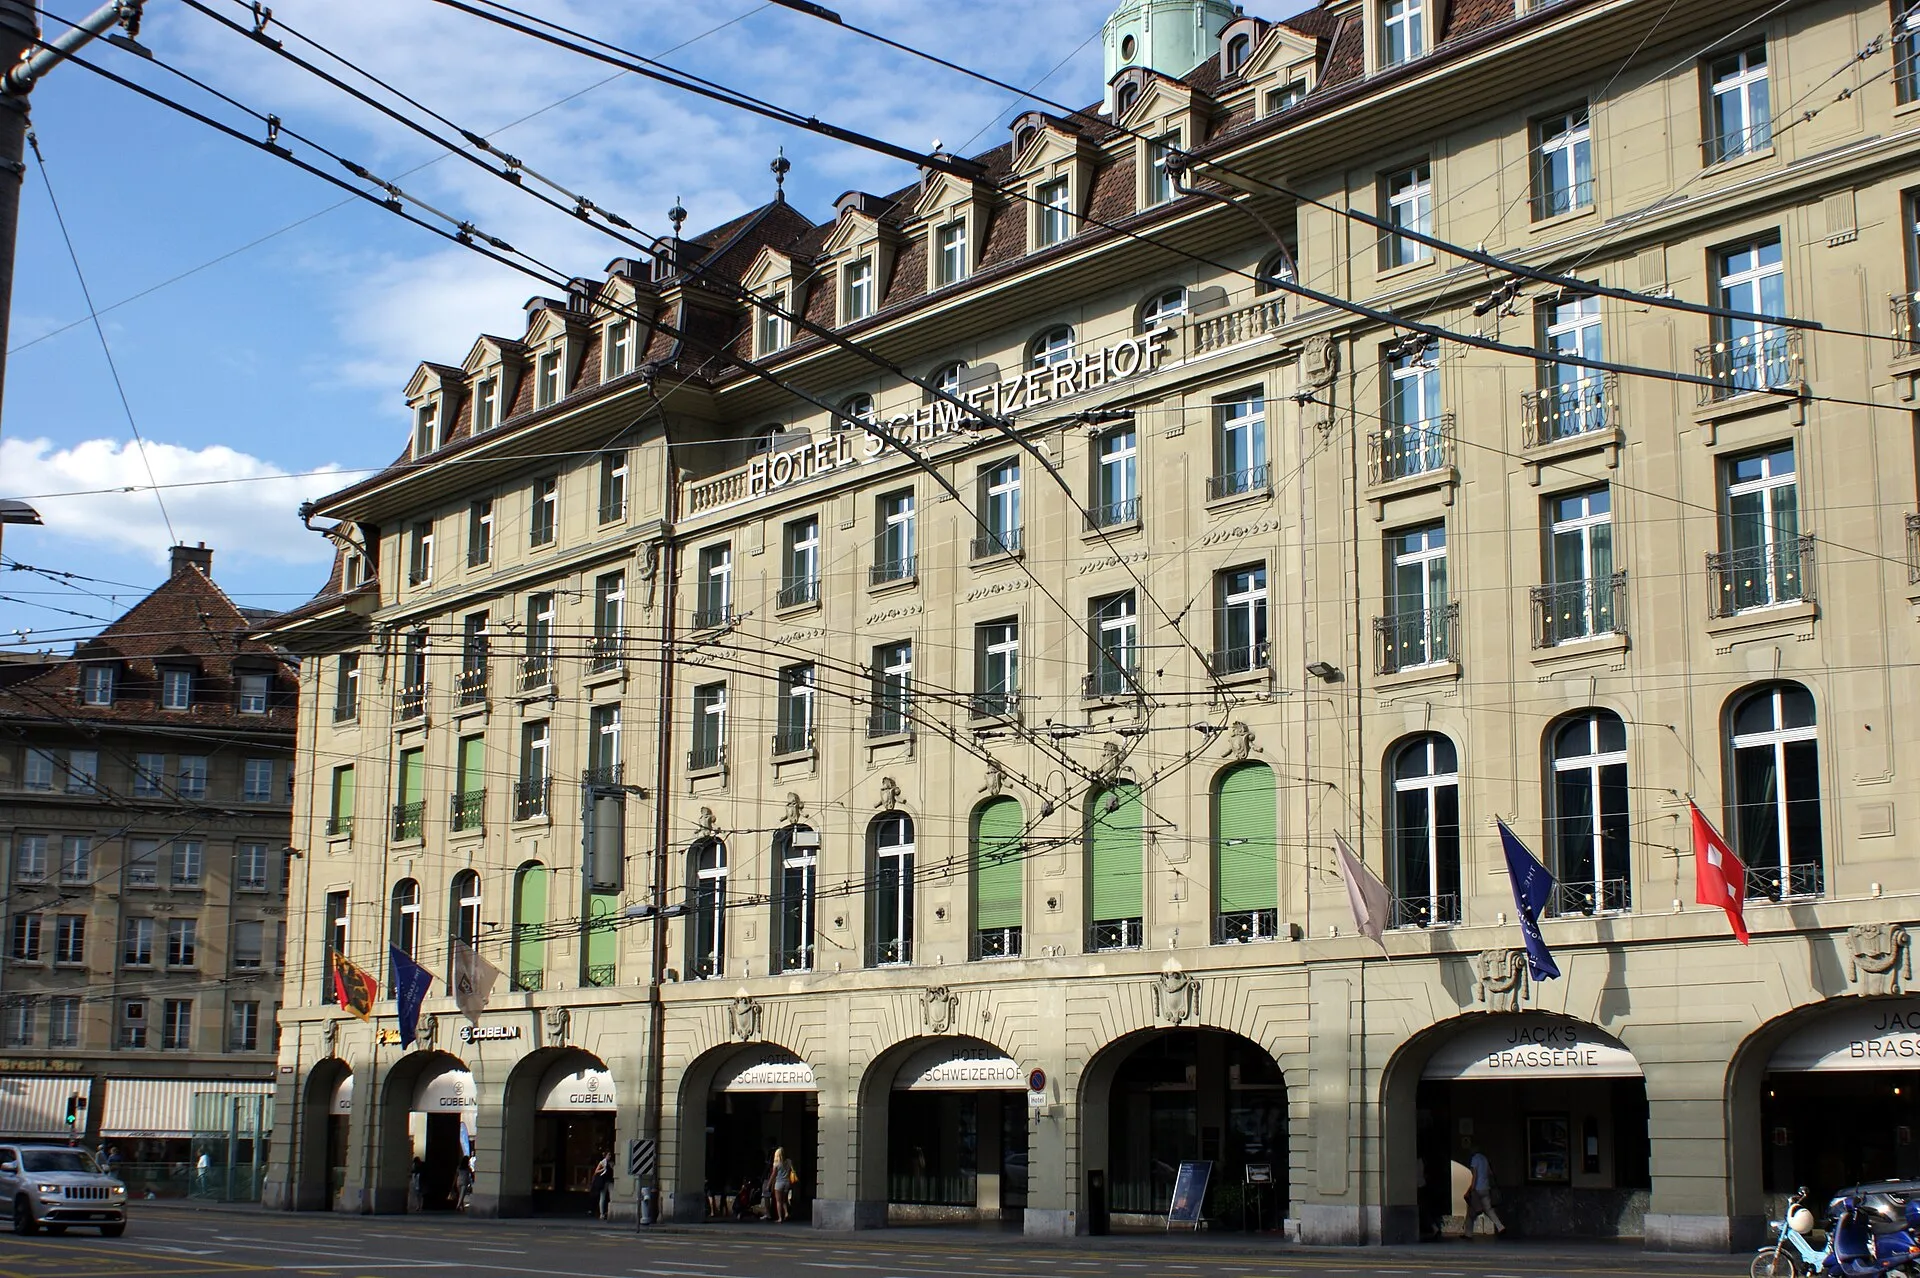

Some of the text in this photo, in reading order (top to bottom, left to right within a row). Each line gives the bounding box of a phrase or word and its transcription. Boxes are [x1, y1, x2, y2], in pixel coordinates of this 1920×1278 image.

[749, 325, 1172, 496] HOTEL SCHWEIZERHOF
[1507, 1026, 1577, 1043] JACK'S
[952, 1049, 993, 1060] HOTEL
[1489, 1050, 1598, 1068] BRASSERIE
[738, 1071, 815, 1084] SCHWEIZERHO
[924, 1067, 1021, 1081] SCHWEIZERHOF
